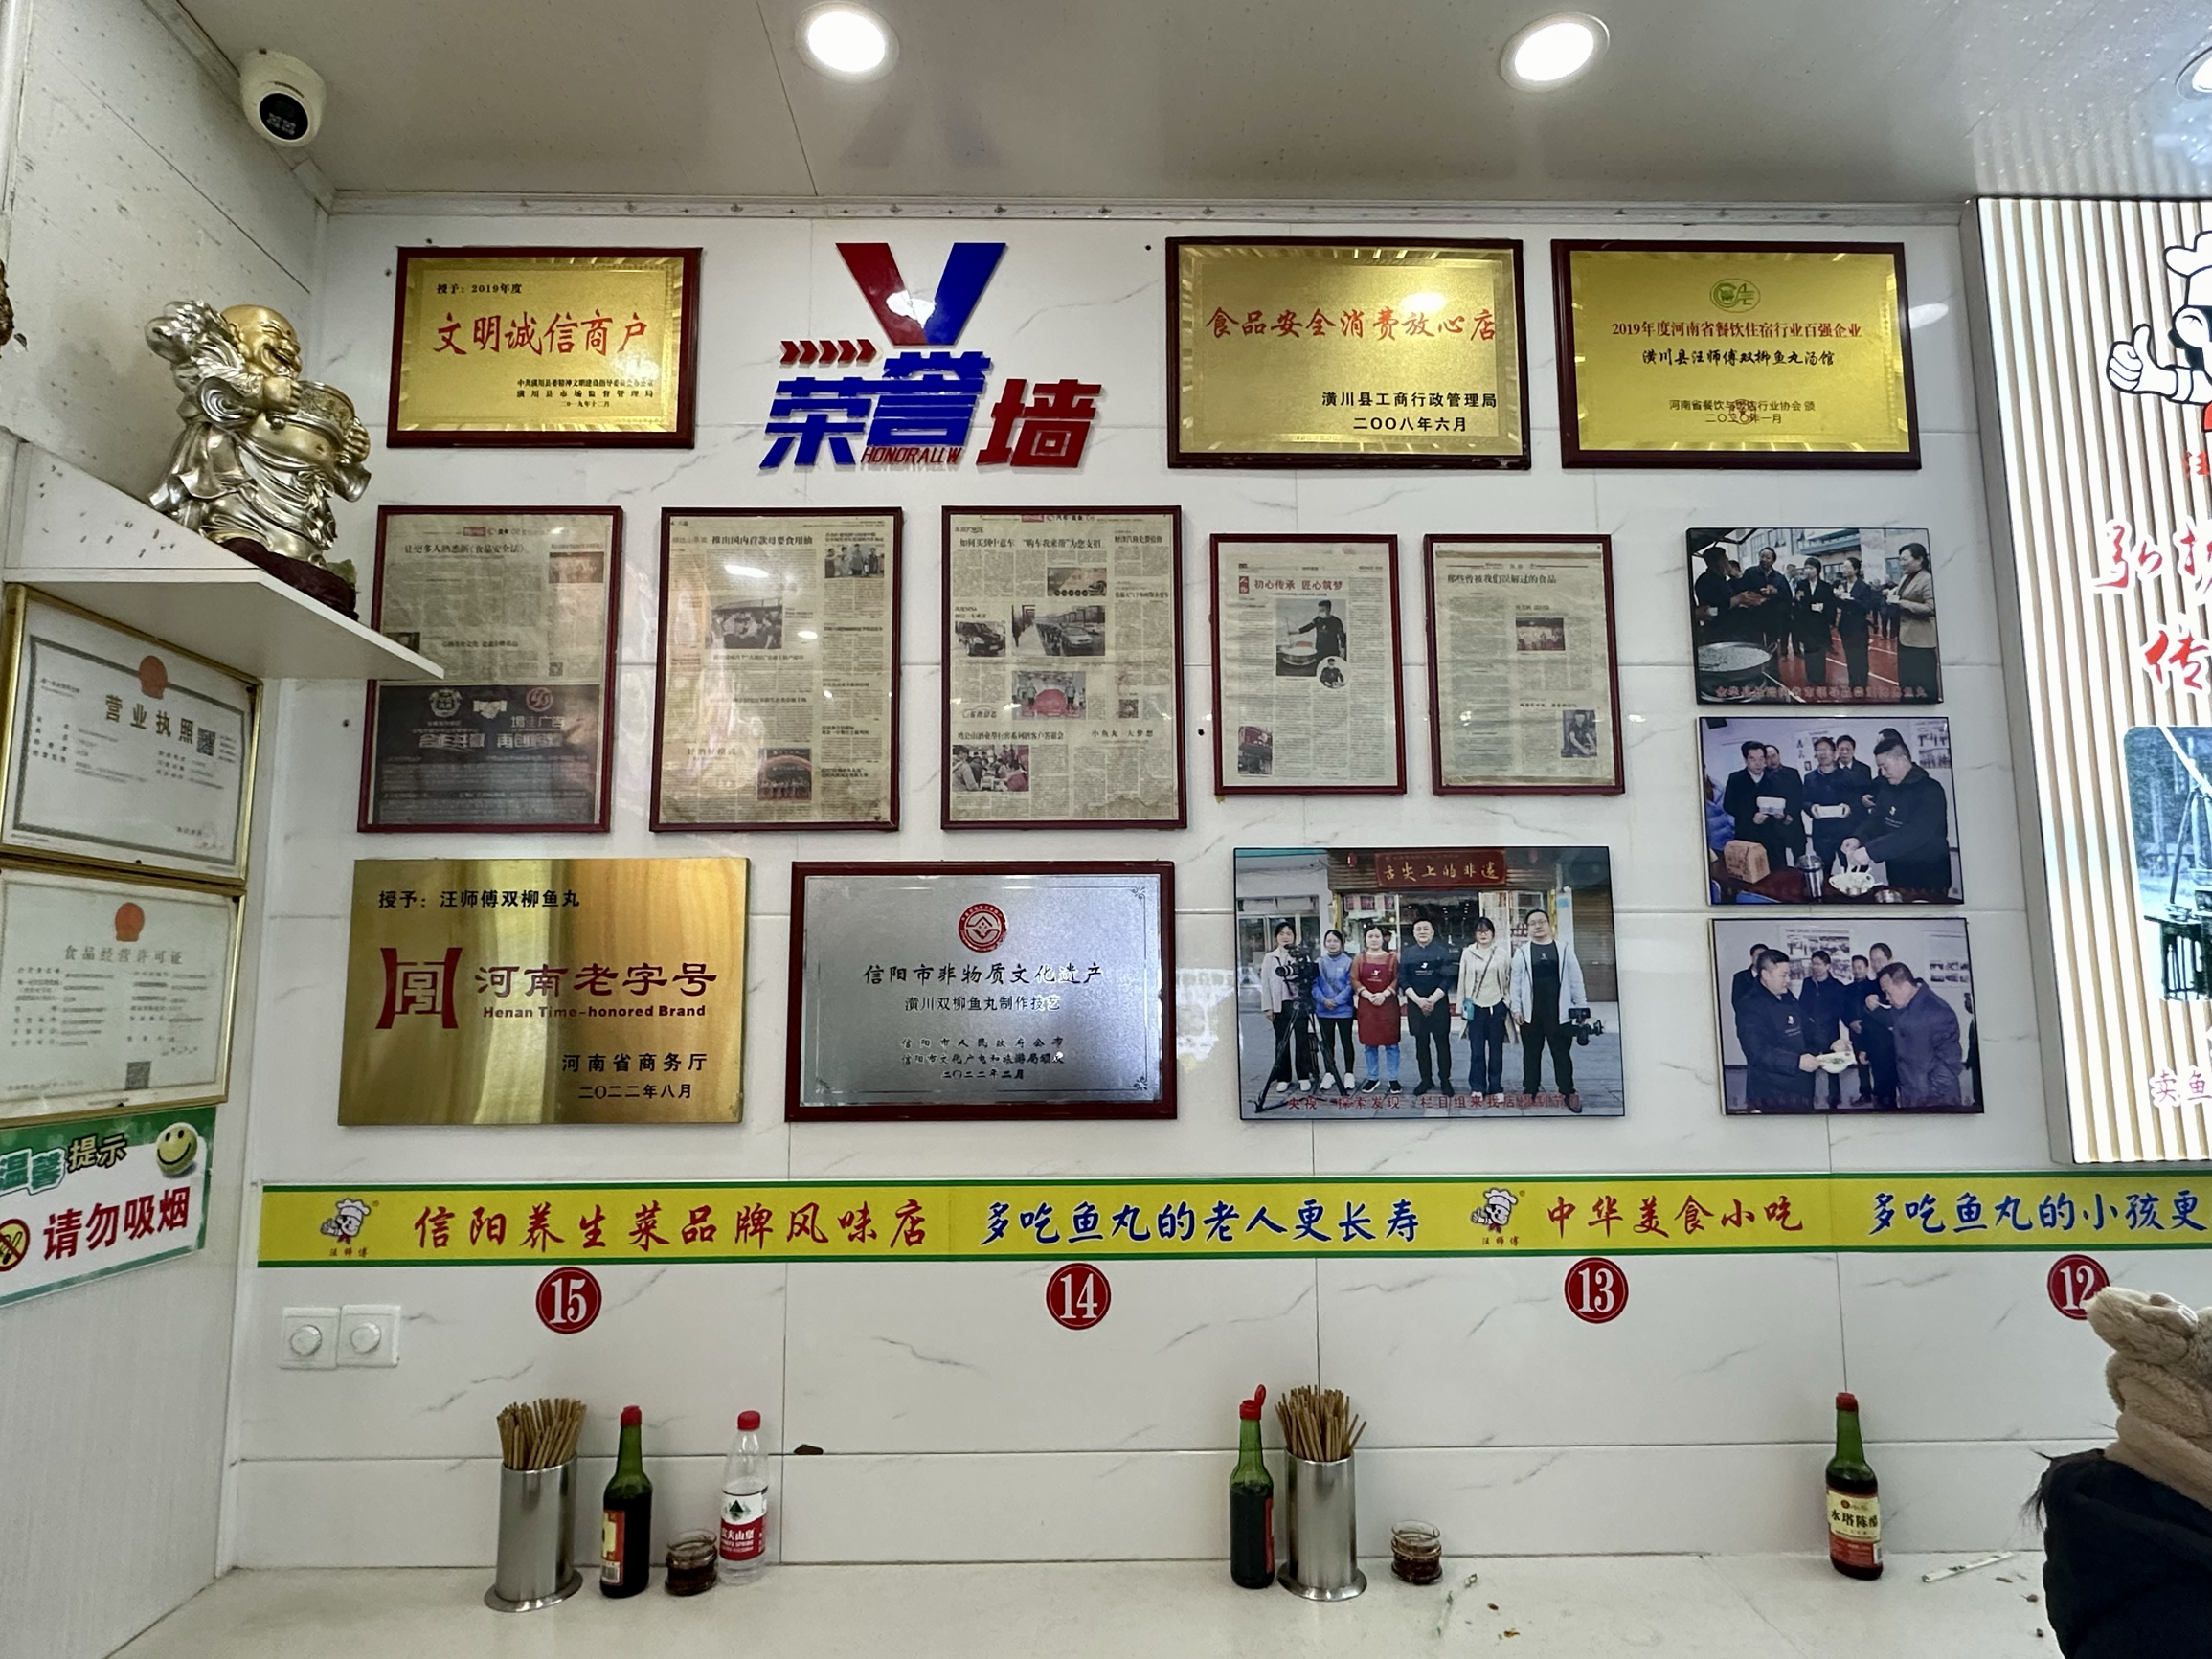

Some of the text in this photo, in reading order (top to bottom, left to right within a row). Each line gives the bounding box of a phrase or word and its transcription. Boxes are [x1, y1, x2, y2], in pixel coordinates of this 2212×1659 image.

[433, 308, 648, 356] 文明诚信商户
[1205, 306, 1497, 342] 食品安全消费放心店
[1612, 322, 1862, 339] 2019年度河南省餐饮住宿行业百强企业
[1641, 347, 1836, 366] 潢川县汪师傅双柳鱼丸汤馆
[758, 351, 1103, 469] 荣誉墙
[1321, 392, 1498, 408] 潢川县工商行政管理局
[1253, 579, 1343, 591] 初心传承 匠心筑梦
[105, 693, 195, 746] 营业执照
[1382, 858, 1501, 885] 舌尖上的非遗
[64, 943, 185, 966] 食品经营许可证
[474, 961, 718, 999] 河南老字号
[862, 961, 1104, 987] 信阳市非物质文化遗产
[483, 1004, 707, 1019] Henan Time-honored Brand
[904, 993, 1061, 1013] 潢川双柳鱼丸制作技艺
[901, 1035, 1065, 1049] 信阳市人民政府公布
[561, 1052, 709, 1073] 河南省商务厅
[43, 1186, 191, 1262] 请勿吸烟
[414, 1199, 927, 1252] 信阳养生菜品牌风味店
[980, 1198, 1421, 1245] 多吃鱼丸的老人更长寿
[1546, 1194, 1804, 1239] 中华美食小吃
[1867, 1189, 2209, 1236] 多吃鱼丸的小孩更
[549, 1277, 587, 1325] 15
[1059, 1273, 1099, 1320] 14
[1577, 1267, 1615, 1313] 13
[2060, 1264, 2096, 1312] 12
